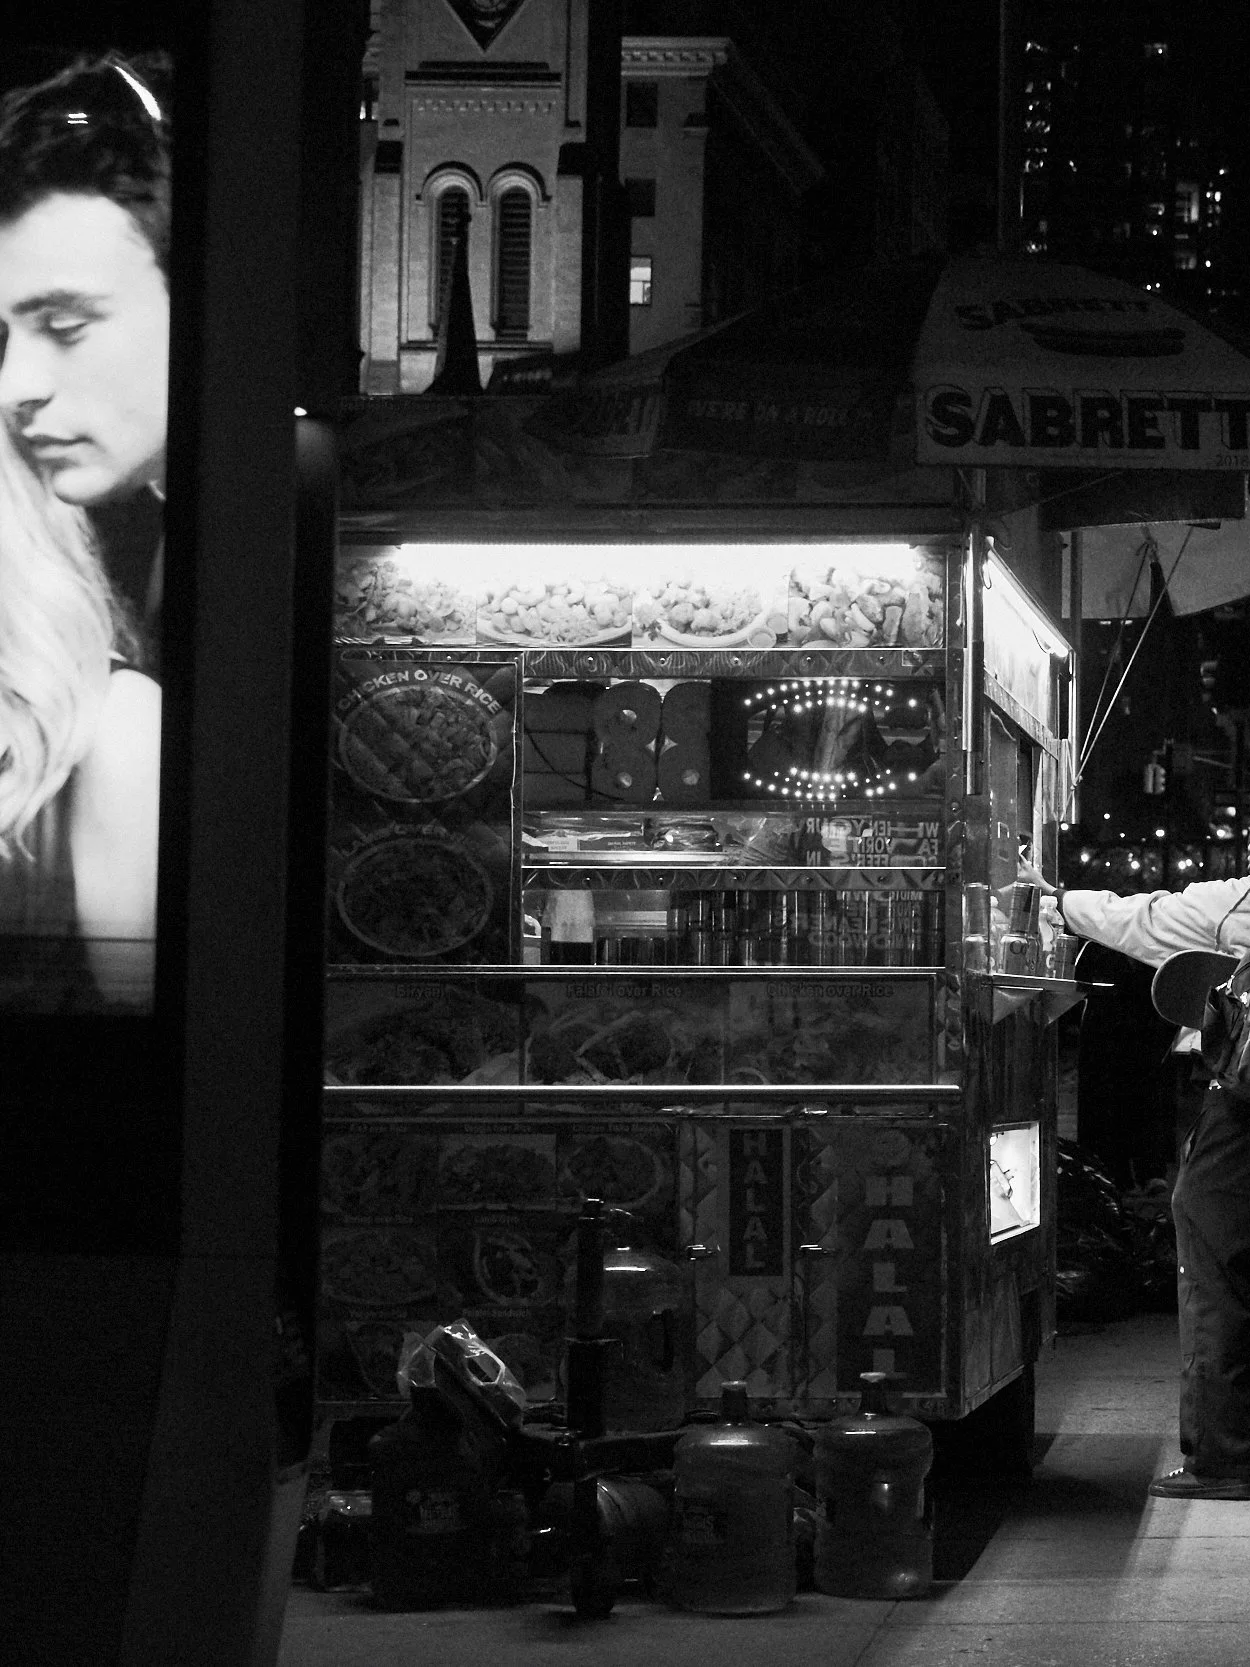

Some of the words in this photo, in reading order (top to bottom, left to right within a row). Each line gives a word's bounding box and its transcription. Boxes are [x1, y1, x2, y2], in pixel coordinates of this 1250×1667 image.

[954, 298, 1150, 329] SABRETT
[337, 670, 409, 711] CHICKEN
[414, 669, 462, 689] OVER
[464, 682, 502, 715] RICE
[650, 984, 682, 998] Rice
[767, 983, 824, 998] Chicken
[861, 983, 895, 998] Rice
[740, 1130, 768, 1270] HALAL
[863, 1175, 915, 1379] HALAL
